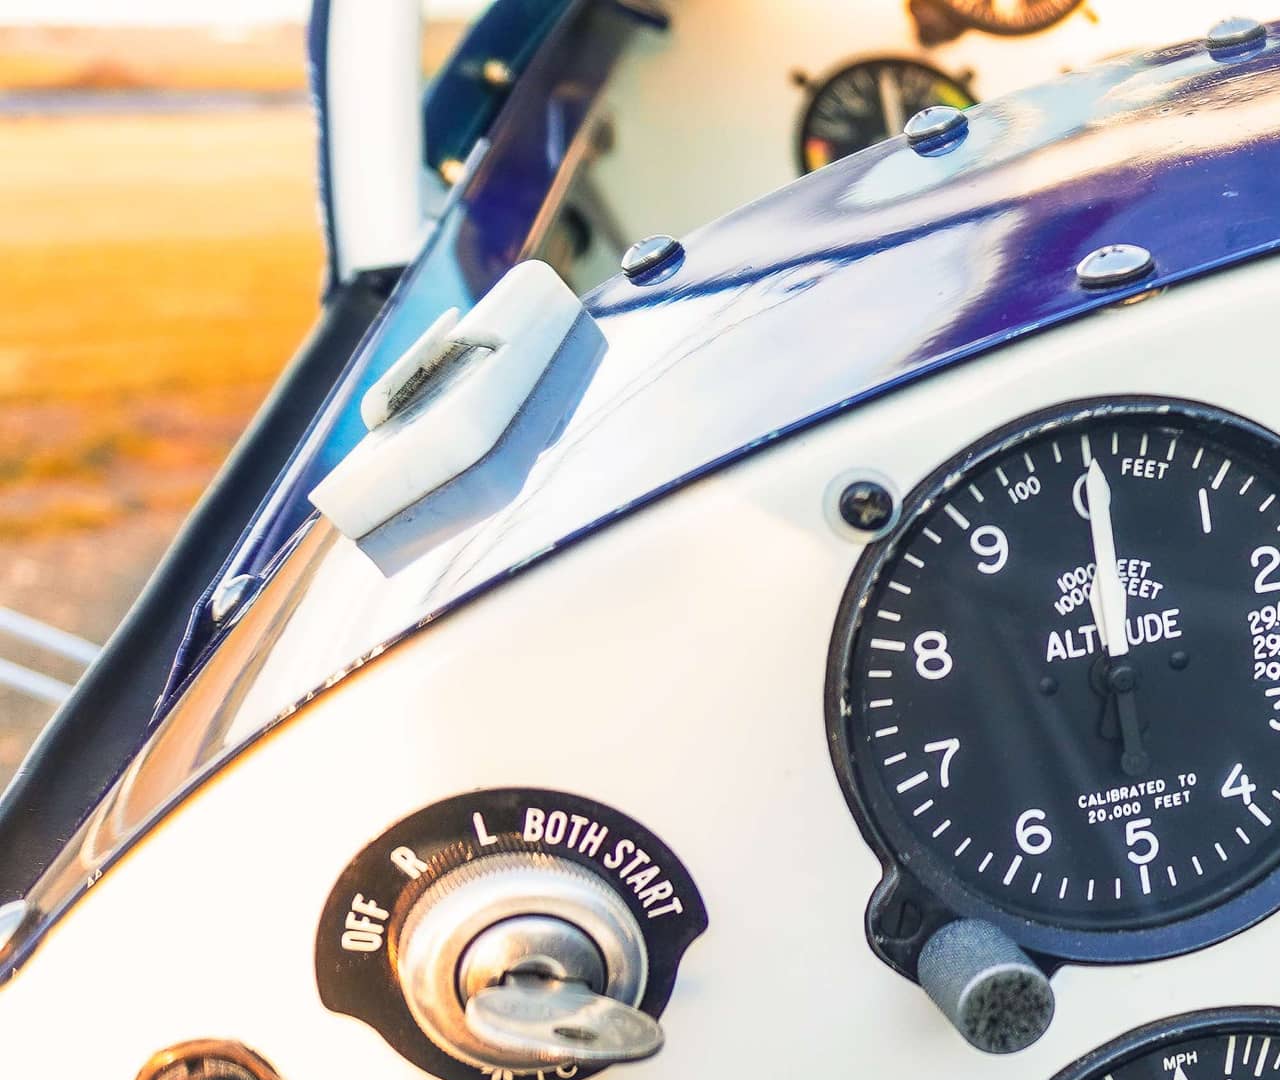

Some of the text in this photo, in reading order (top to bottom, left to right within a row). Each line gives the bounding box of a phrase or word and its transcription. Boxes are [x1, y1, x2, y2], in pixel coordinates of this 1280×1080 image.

[1007, 476, 1041, 504] 100
[1122, 458, 1169, 479] FEET
[970, 524, 1009, 574] 9
[914, 630, 952, 679] 8
[1047, 608, 1182, 662] ALTUDE
[924, 739, 960, 787] 7
[1221, 763, 1256, 804] 4
[1078, 773, 1197, 808] CALIBRATED TO
[1154, 791, 1191, 810] FEET
[472, 812, 497, 846] L
[523, 808, 608, 856] BOTH
[1015, 808, 1052, 855] 6
[1125, 817, 1158, 864] 5
[391, 846, 428, 879] R
[604, 839, 682, 919] START
[342, 893, 390, 952] OFF
[1162, 1051, 1198, 1071] MPH
